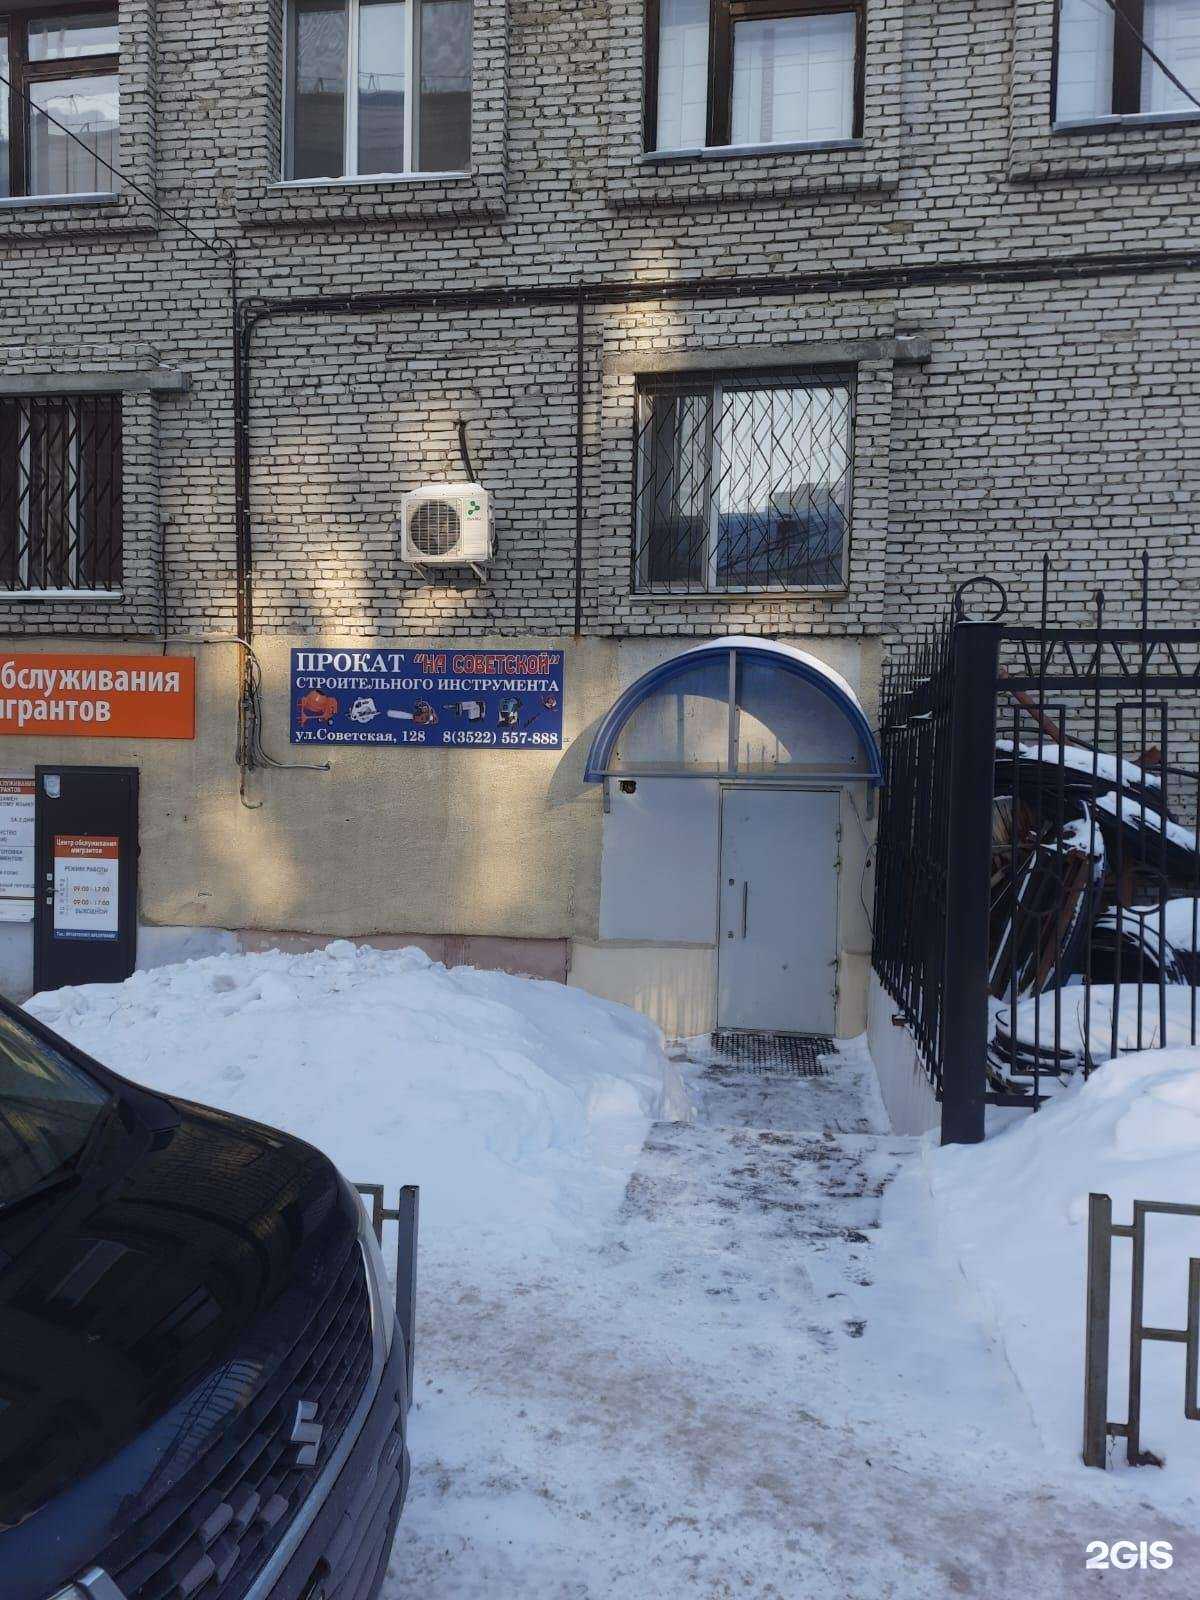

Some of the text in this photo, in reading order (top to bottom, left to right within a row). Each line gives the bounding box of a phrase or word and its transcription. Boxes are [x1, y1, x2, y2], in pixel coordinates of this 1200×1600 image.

[296, 652, 404, 673] ПРОКАТ
[296, 676, 559, 692] СТРОИТЕЛЬНОГО ИНСТРУМЕНТА
[402, 731, 426, 742] 128
[443, 731, 497, 744] 8(3522)
[501, 732, 558, 745] 557-888
